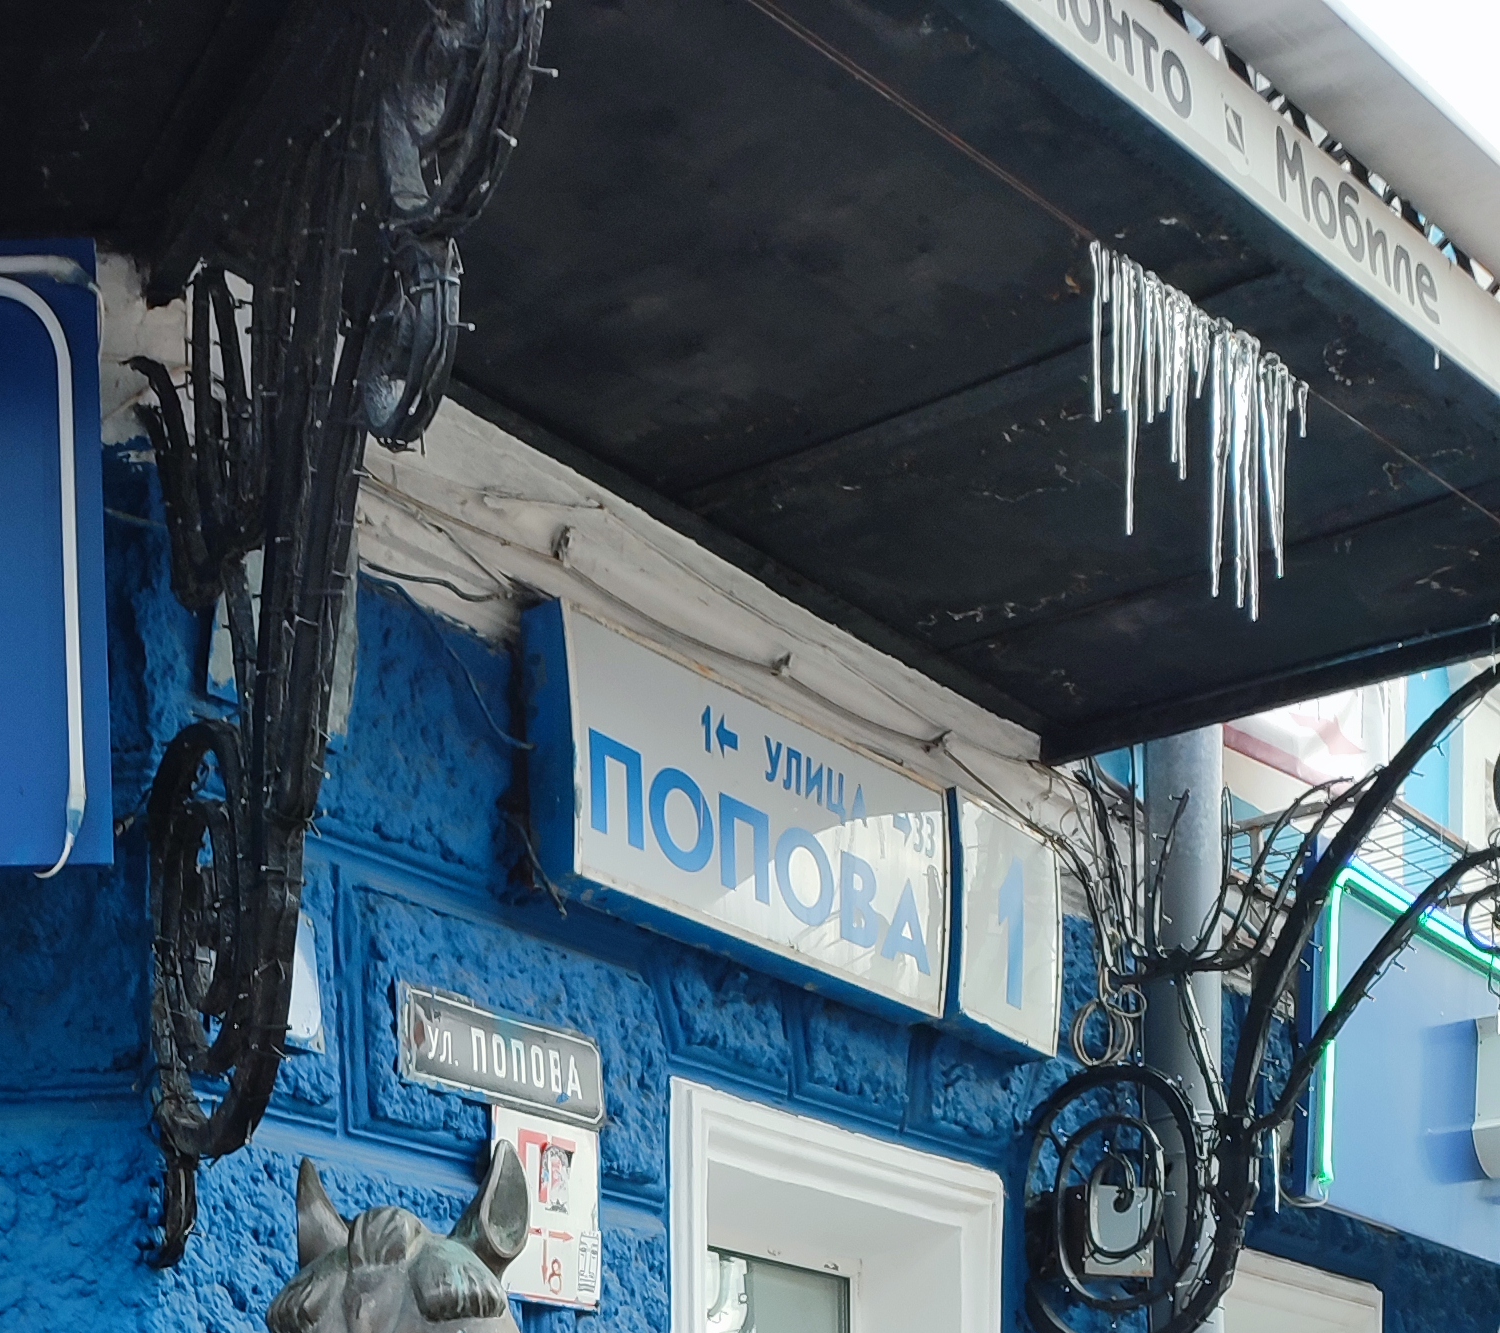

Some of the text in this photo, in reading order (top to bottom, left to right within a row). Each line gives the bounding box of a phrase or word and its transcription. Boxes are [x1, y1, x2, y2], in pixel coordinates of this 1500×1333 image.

[701, 704, 712, 754] 1
[764, 735, 868, 828] УЛИЦА
[589, 727, 931, 977] ПОПОВА
[998, 856, 1024, 1010] 1
[470, 1026, 583, 1101] ПОПОВА
